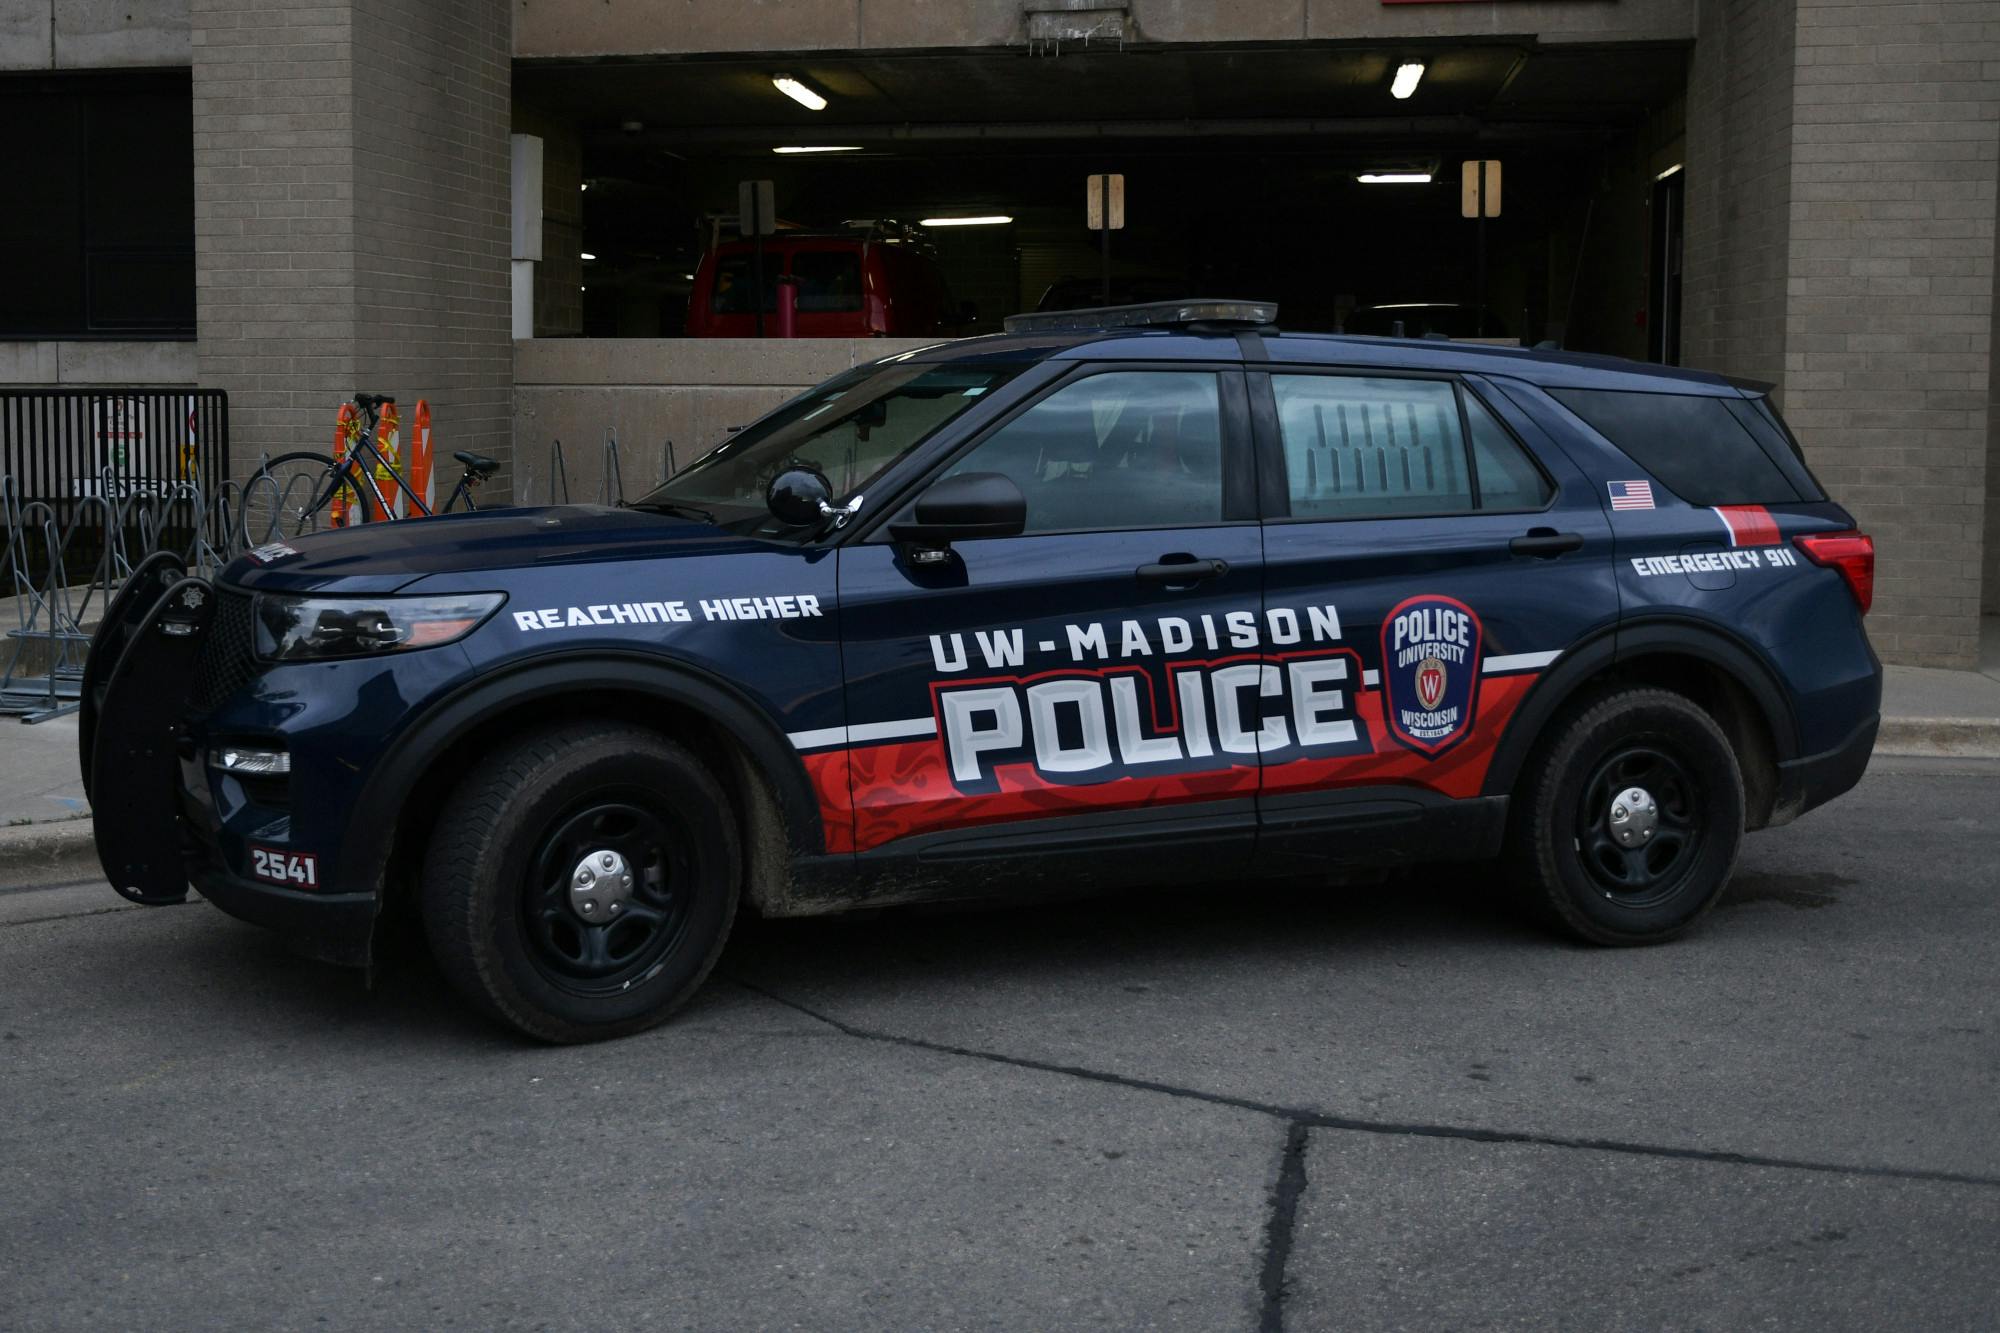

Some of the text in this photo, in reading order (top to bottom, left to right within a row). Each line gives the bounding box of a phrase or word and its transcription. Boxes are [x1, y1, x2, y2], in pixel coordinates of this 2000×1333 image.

[1630, 549, 1797, 576] EMERGENCY 911
[512, 595, 824, 631] REACHING HIGHER
[1394, 608, 1470, 651] POLICE
[929, 605, 1341, 672] UW-MADISON
[1398, 642, 1465, 668] UNIVERSITY
[1422, 673, 1440, 700] W
[941, 657, 1358, 782] POLICE
[1401, 706, 1458, 728] WISCONSIN
[253, 849, 316, 885] 2541
